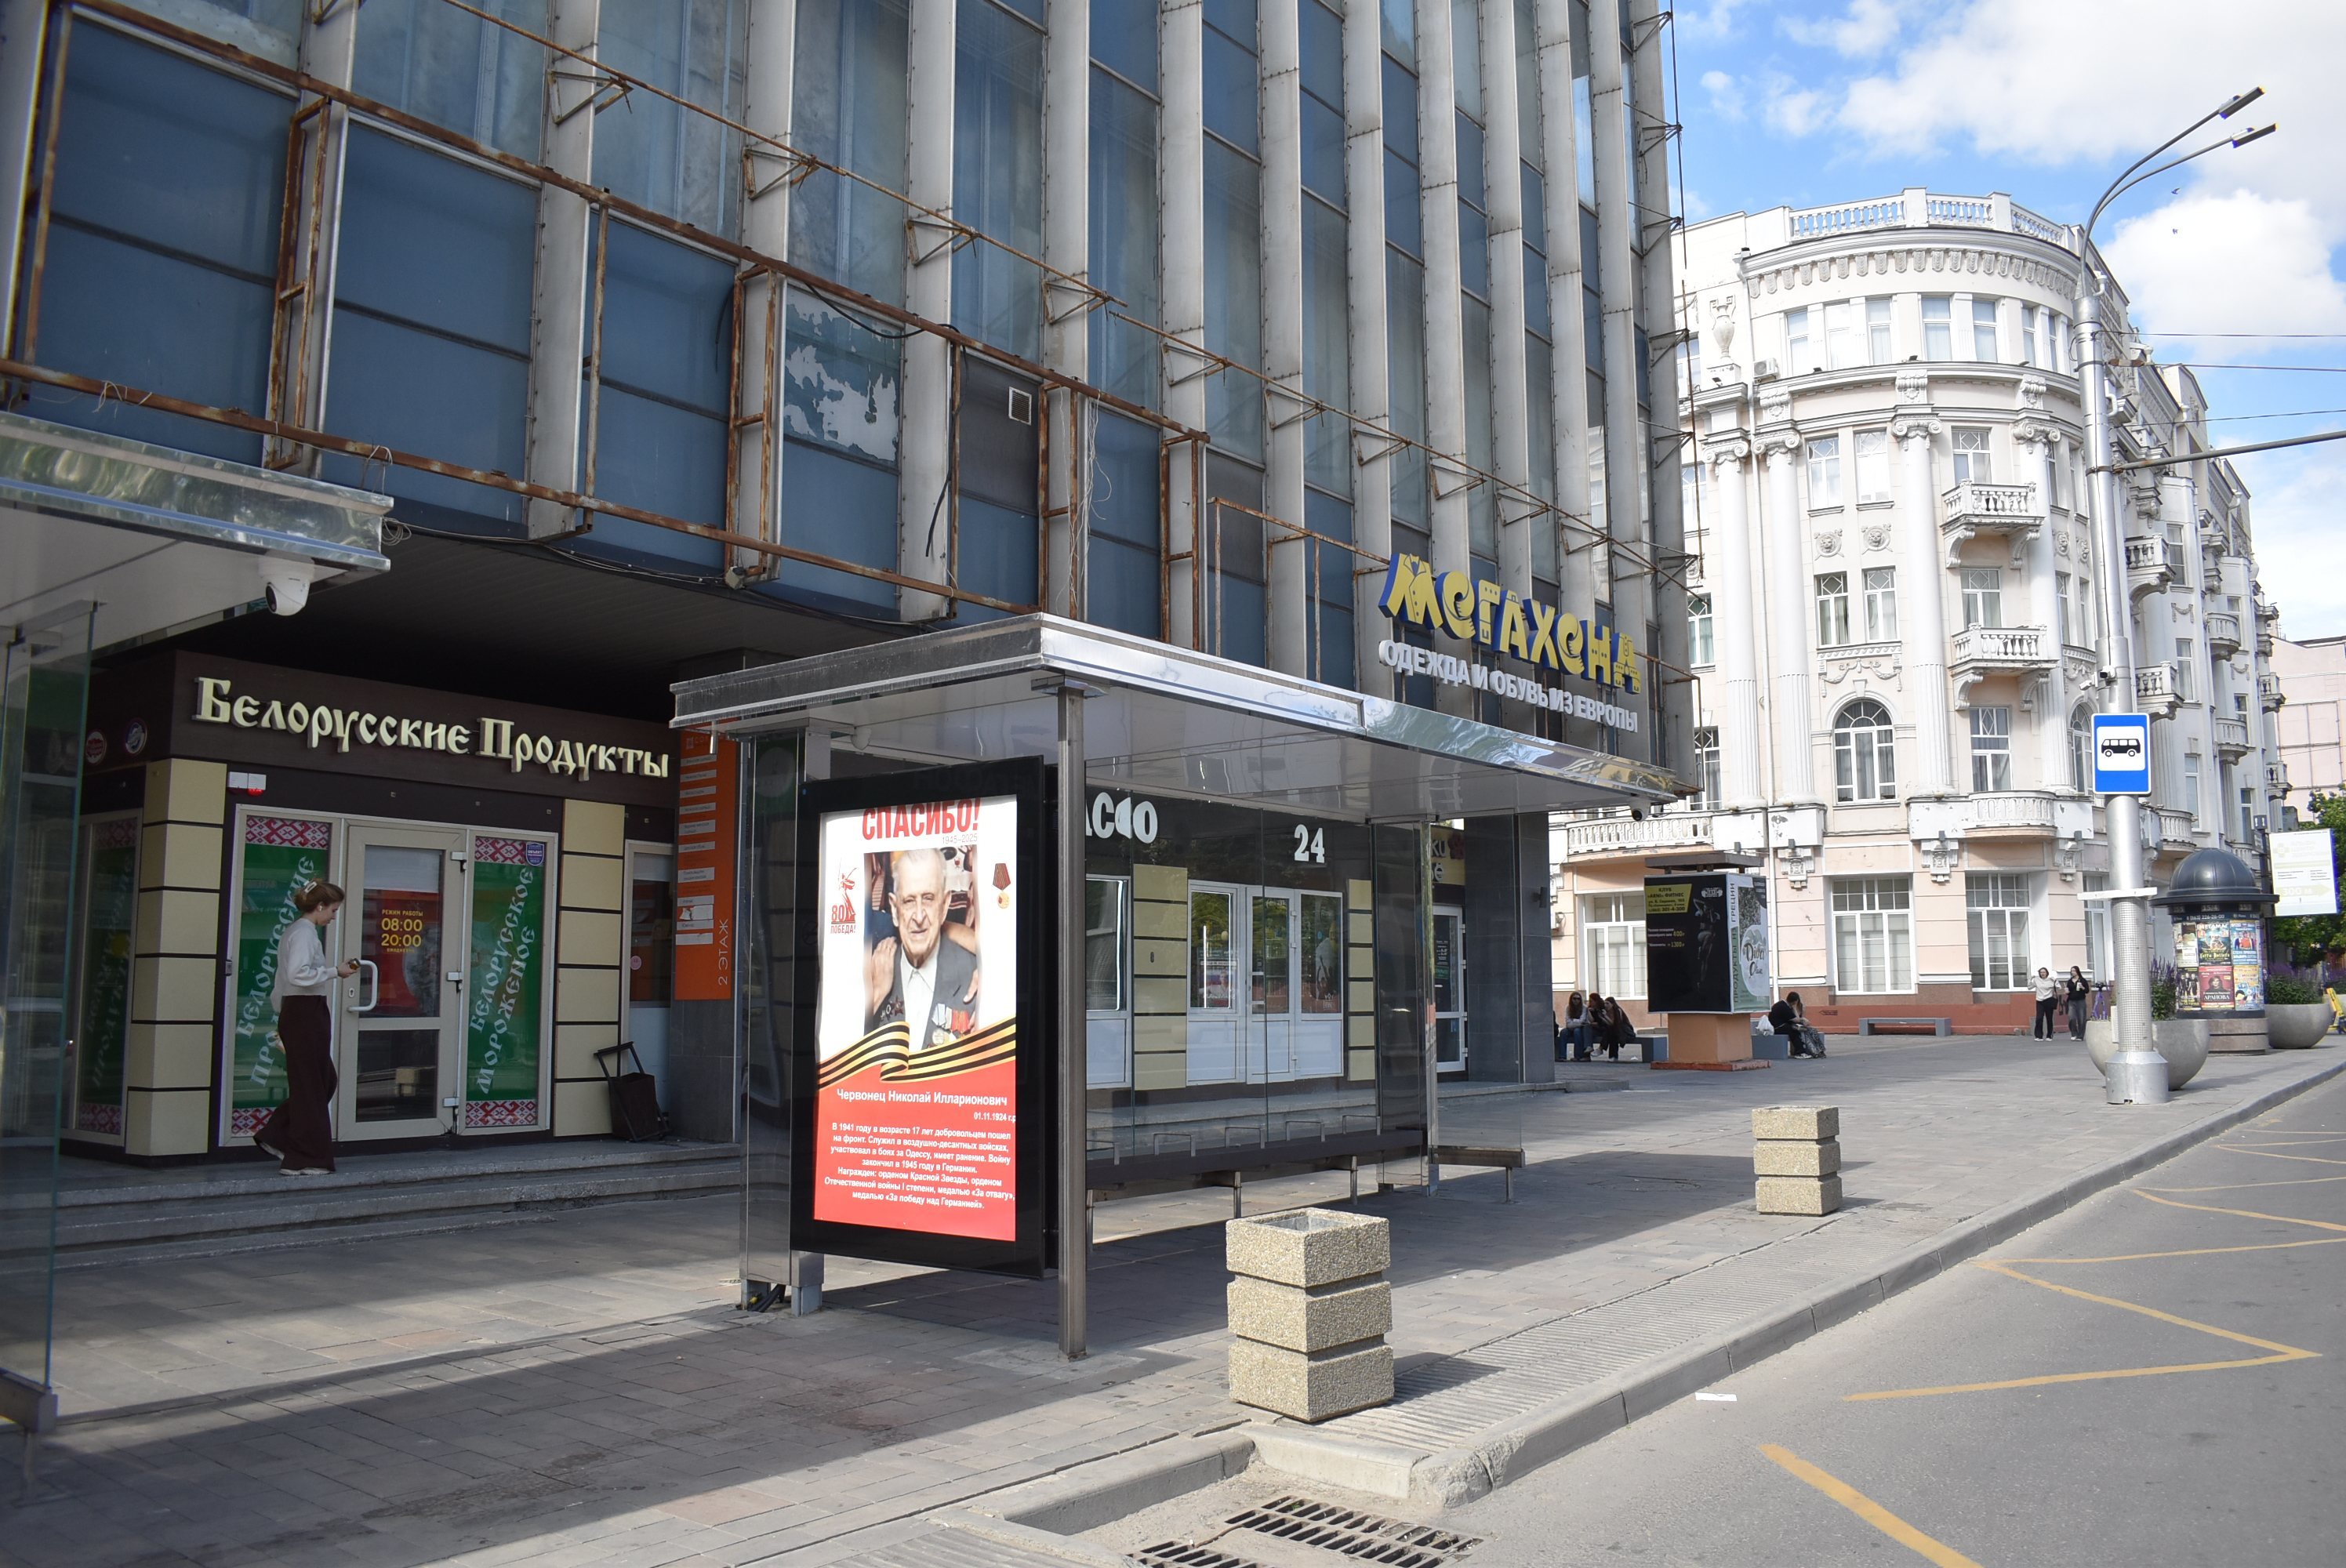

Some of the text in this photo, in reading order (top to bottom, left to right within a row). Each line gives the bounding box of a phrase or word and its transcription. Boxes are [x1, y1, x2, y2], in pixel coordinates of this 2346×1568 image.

[1378, 640, 1639, 733] ОДЕЖДА И ОБУВЬ ИЗ ЕВРОПЫ
[191, 677, 470, 753] Белорусские
[476, 717, 669, 781] Продукты
[862, 797, 982, 840] СПАСИБО!
[1294, 824, 1325, 863] 24
[832, 904, 844, 922] 80
[381, 918, 423, 932] 08:00
[830, 924, 856, 935] ПОБЕДА!
[381, 933, 422, 947] 20:00
[470, 867, 533, 1034] БЕЛОРУССКОЕ
[718, 918, 728, 985] 2 ЭТАЖ
[476, 925, 536, 1094] МОРОЖЕНОЕ
[837, 1088, 1008, 1107] Червонец Николай Илларионович
[974, 1112, 1007, 1122] 01.11.1924
[839, 1123, 854, 1131] 1941
[855, 1125, 872, 1134] году
[935, 1128, 986, 1139] добровольцем
[843, 1134, 866, 1144] фронт.
[868, 1135, 895, 1145] Служил
[902, 1138, 978, 1149] воздушно-десантных
[979, 1142, 1009, 1152] войсках,
[830, 1146, 871, 1155] участвовал
[878, 1147, 895, 1156] боях
[905, 1149, 932, 1160] Одессу,
[955, 1153, 986, 1162] ранение.
[988, 1154, 1011, 1166] Войну
[862, 1159, 894, 1167] закончил
[902, 1160, 918, 1169] 1945
[919, 1163, 935, 1171] году
[942, 1163, 978, 1173] Германии.
[837, 1167, 1002, 1186] Награжден: орденом Красной Звезды, орденом
[824, 1176, 876, 1189] Отечественной
[906, 1185, 936, 1193] степени,
[937, 1186, 971, 1196] медалью
[971, 1188, 984, 1197] «За
[986, 1190, 1015, 1201] отвагу»,
[852, 1191, 985, 1209] медалью «За победу над Германией».
